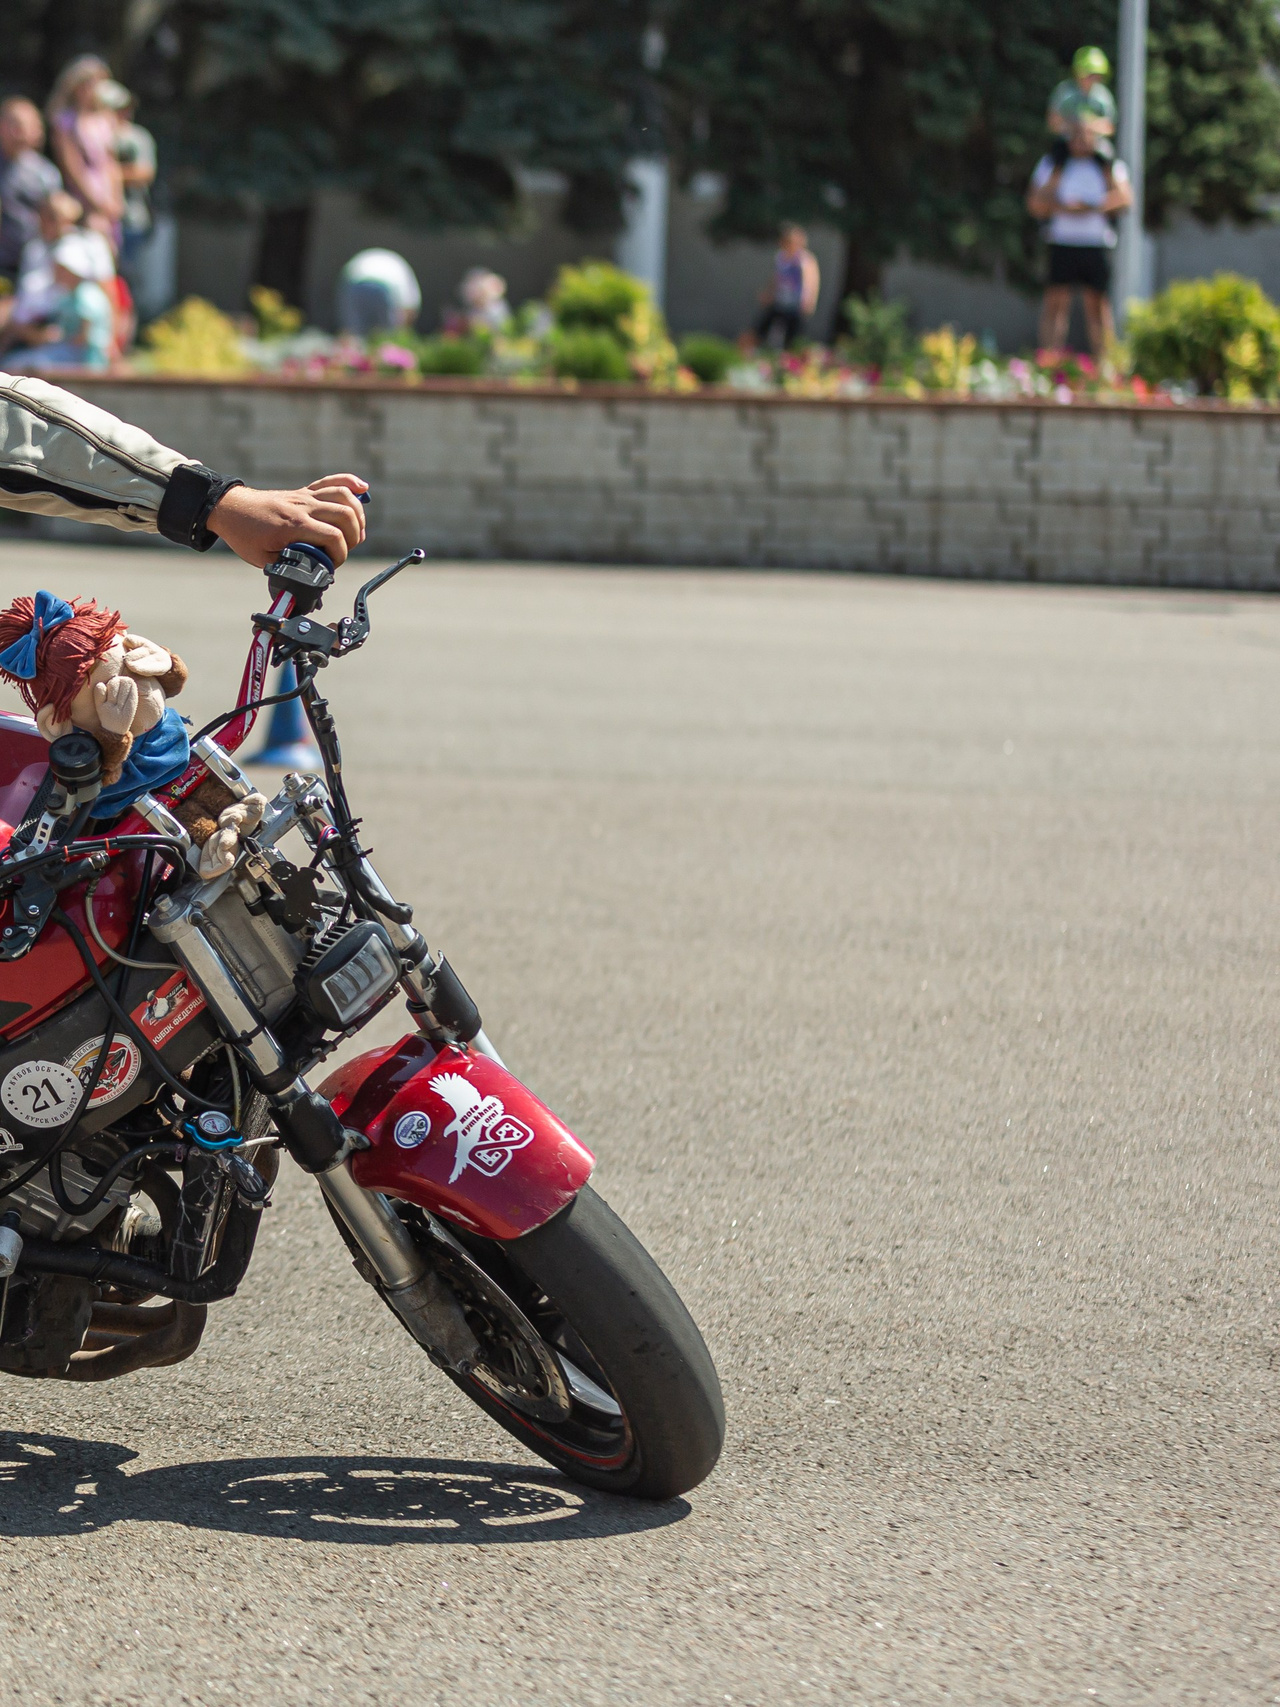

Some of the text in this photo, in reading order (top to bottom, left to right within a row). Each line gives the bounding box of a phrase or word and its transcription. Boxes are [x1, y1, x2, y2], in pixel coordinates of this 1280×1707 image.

[152, 1023, 174, 1045] КУБОК
[9, 1066, 32, 1086] КУБОК
[22, 1078, 65, 1113] 21
[24, 1114, 50, 1124] КУРСК
[460, 1104, 479, 1124] moto
